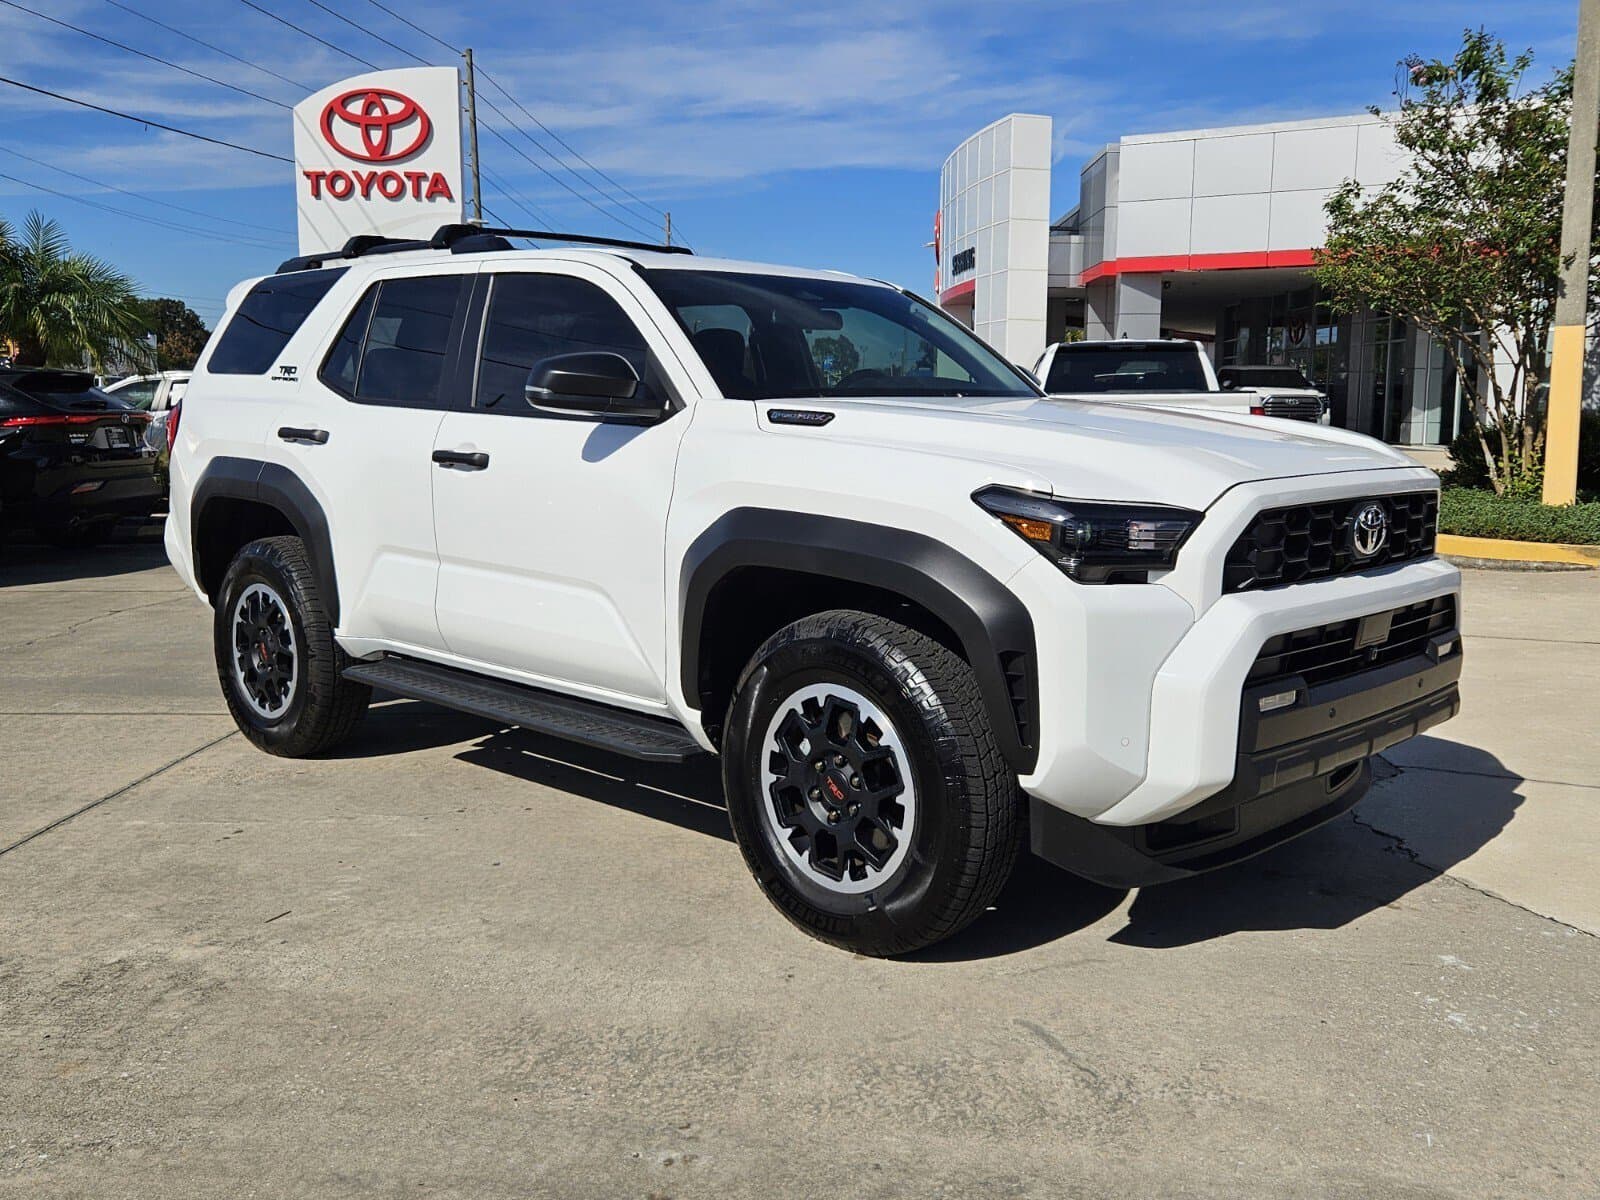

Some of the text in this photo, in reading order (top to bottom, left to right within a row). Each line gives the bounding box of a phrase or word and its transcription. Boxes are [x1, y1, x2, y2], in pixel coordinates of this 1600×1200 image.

[303, 170, 453, 200] TOYOTA
[279, 366, 297, 376] TRD
[826, 776, 844, 800] TRD
